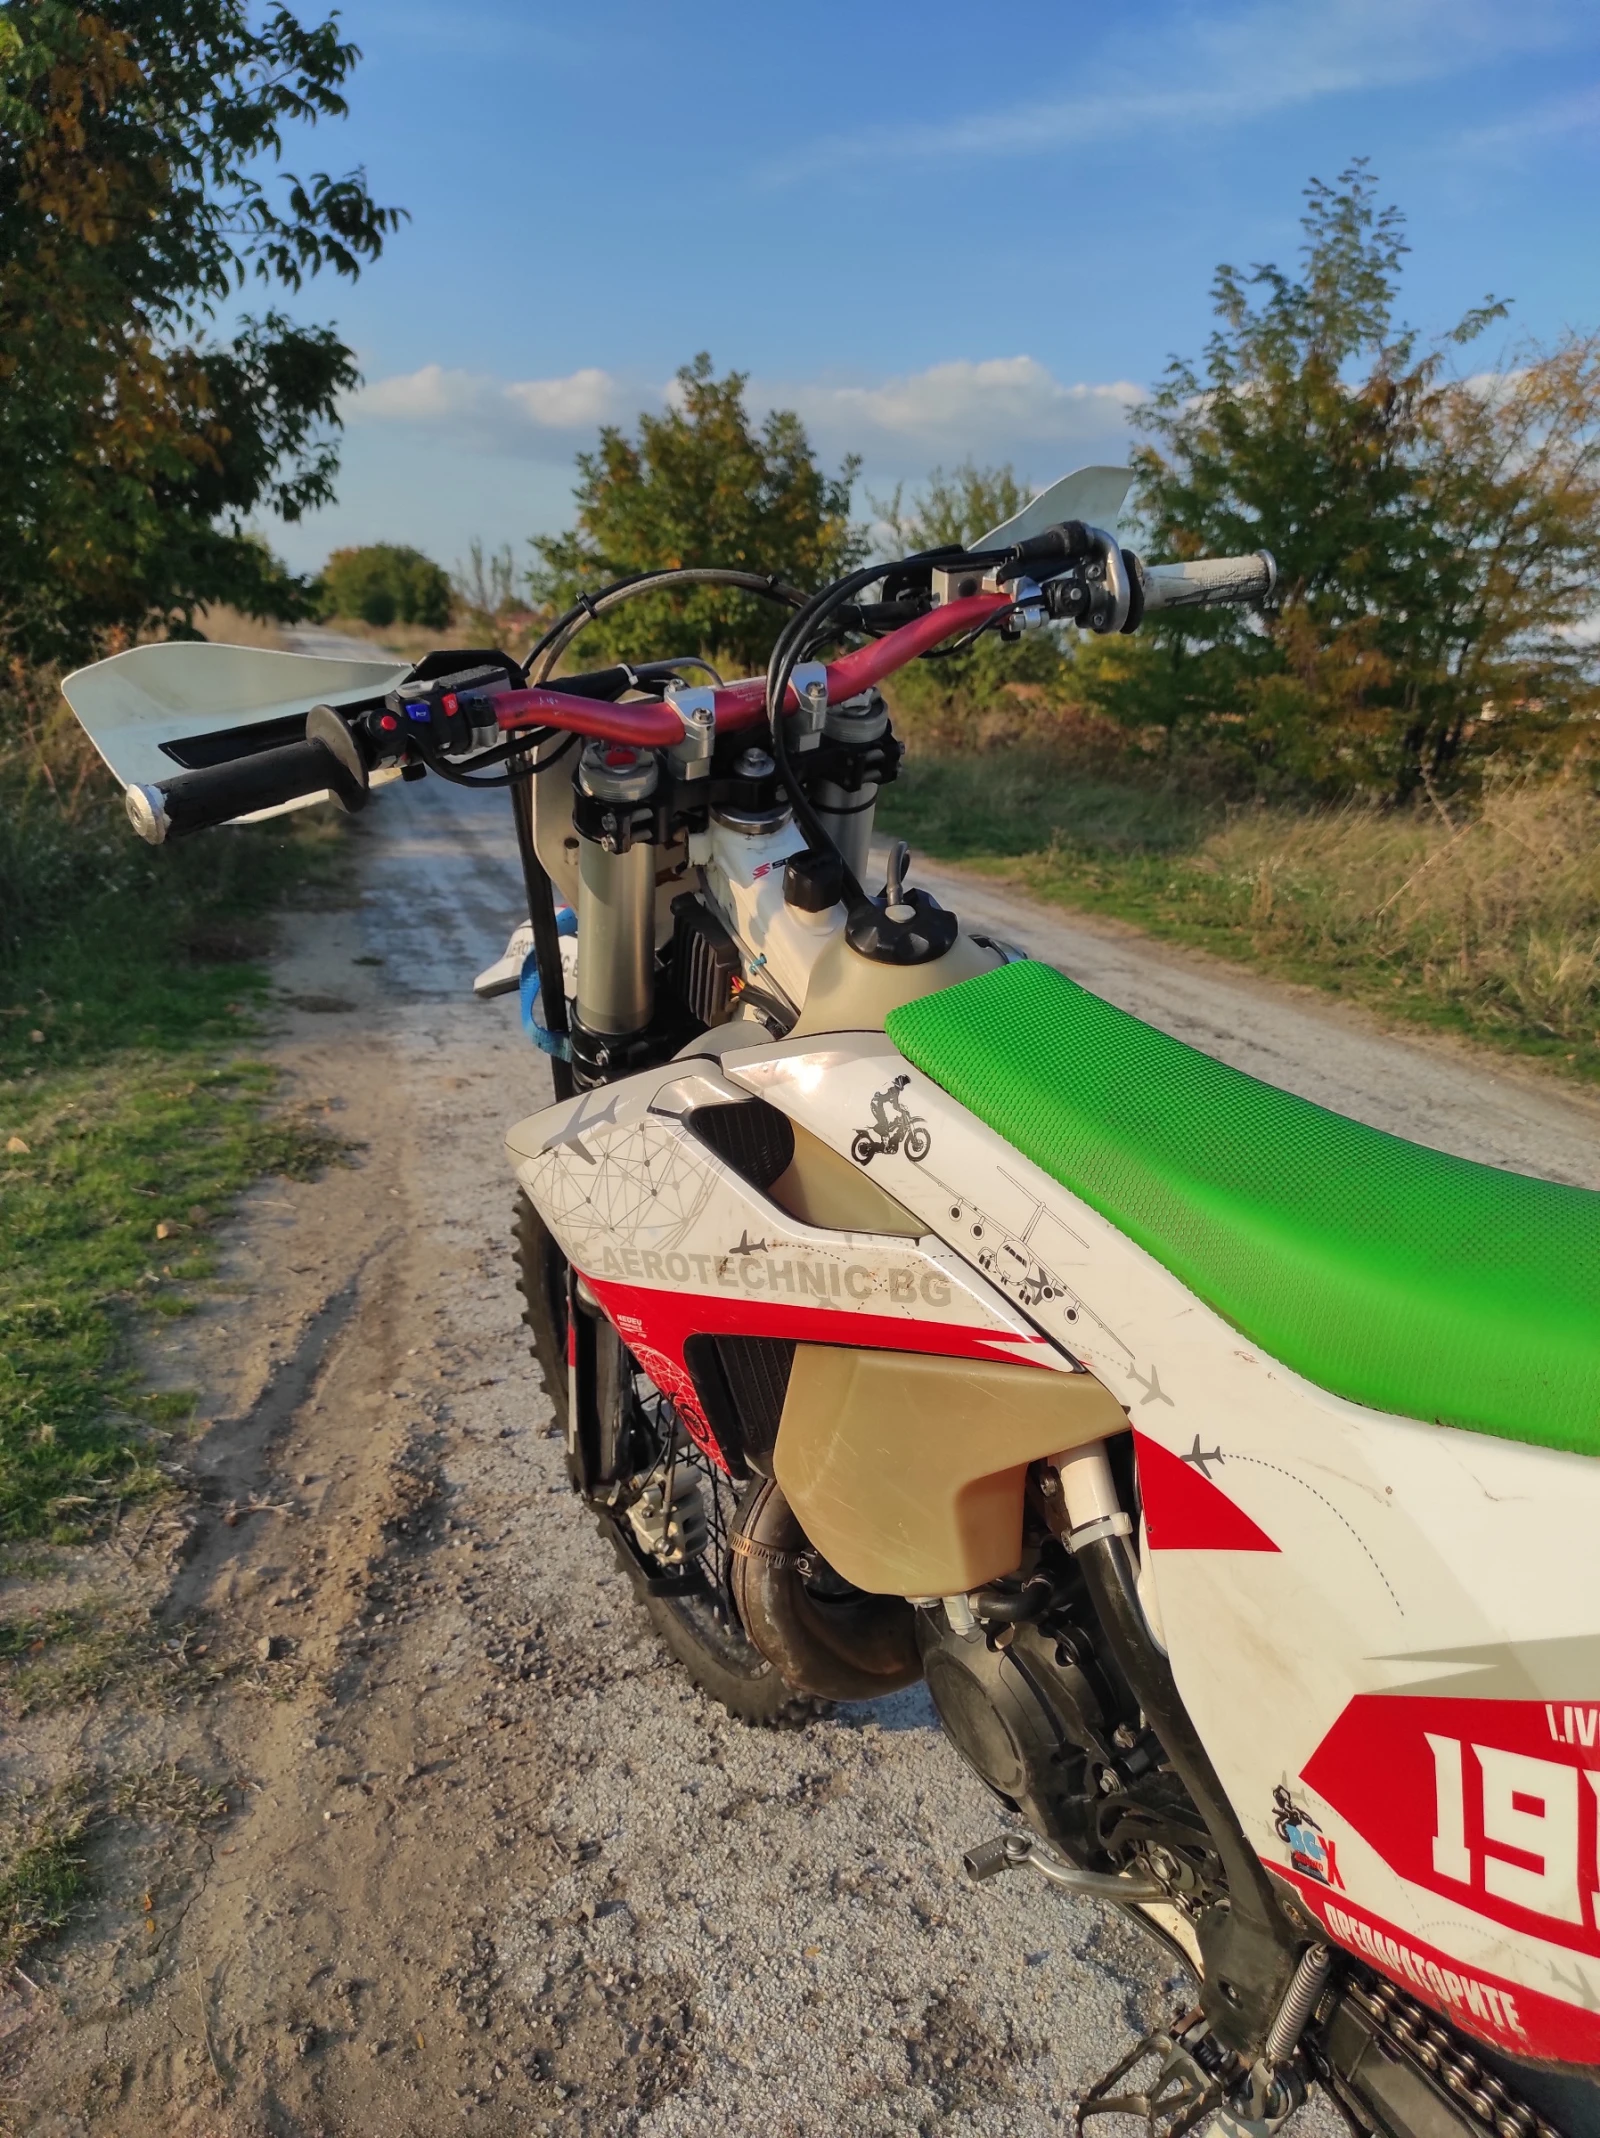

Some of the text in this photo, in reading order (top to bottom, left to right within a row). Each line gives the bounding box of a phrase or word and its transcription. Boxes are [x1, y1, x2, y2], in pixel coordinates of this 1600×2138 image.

[602, 1245, 873, 1300] AEROTECHNIC
[887, 1267, 952, 1308] BG
[1545, 1703, 1600, 1747] LIV
[1323, 1900, 1528, 2038] ПРЕПАРАТОРИТЕ
